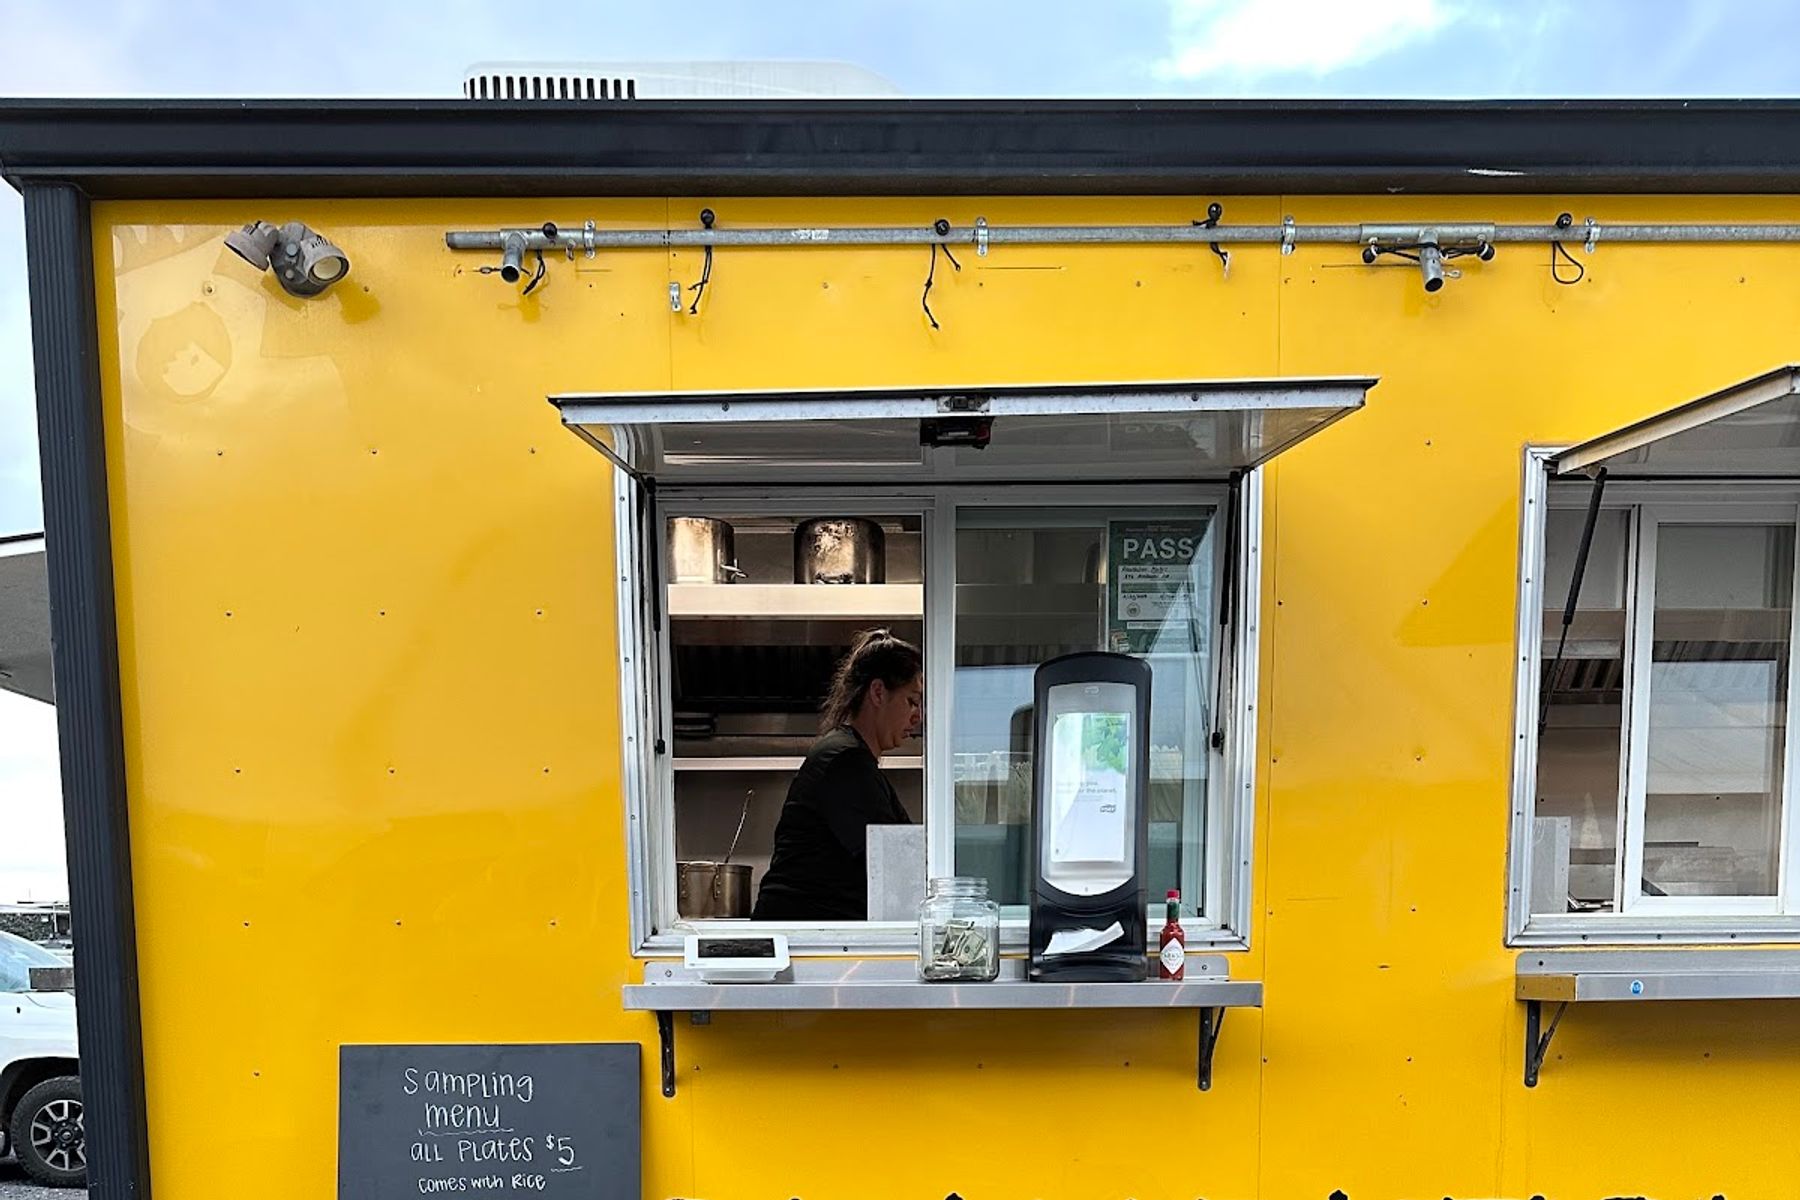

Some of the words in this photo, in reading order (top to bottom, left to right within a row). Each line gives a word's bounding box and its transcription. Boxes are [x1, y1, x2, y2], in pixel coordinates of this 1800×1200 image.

[1123, 538, 1194, 559] PASS
[425, 1103, 500, 1128] menu
[546, 1134, 574, 1165] $5
[419, 1178, 466, 1193] comes
[471, 1176, 503, 1188] with
[512, 1174, 545, 1190] Rice
